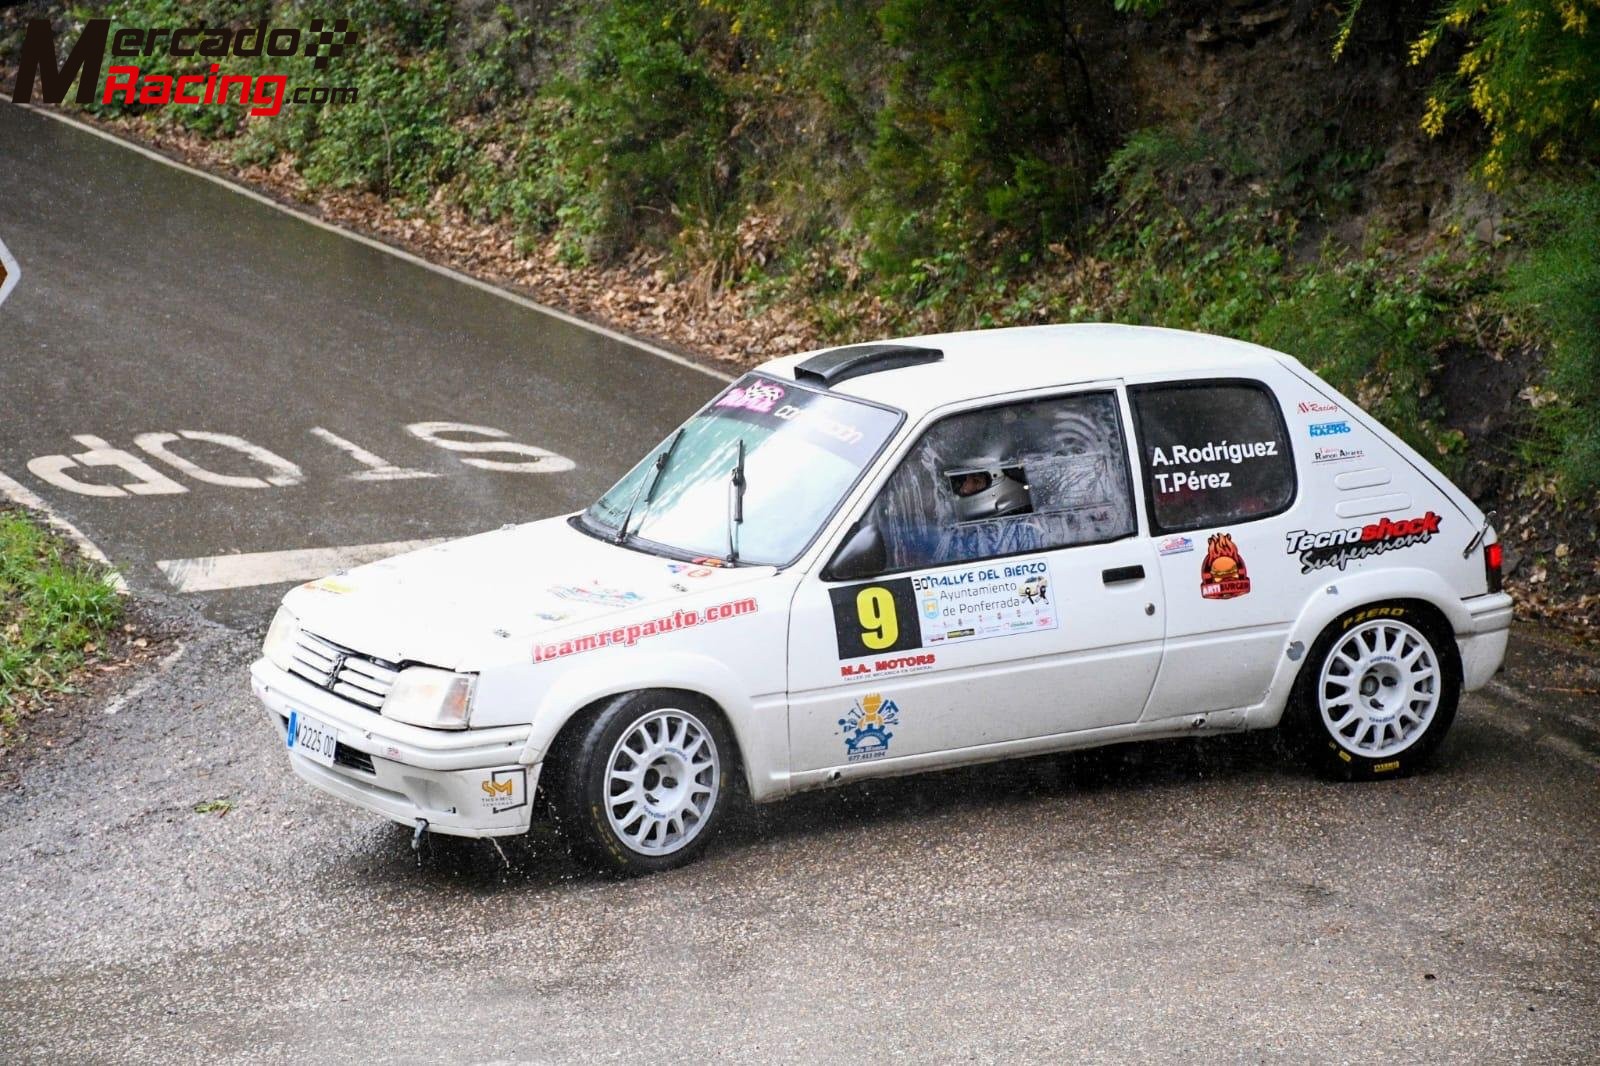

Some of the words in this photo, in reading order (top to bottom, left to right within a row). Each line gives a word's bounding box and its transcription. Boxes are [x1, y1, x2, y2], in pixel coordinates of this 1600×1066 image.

[26, 421, 577, 498] STOP
[1152, 440, 1278, 467] A.Rodríguez
[1155, 471, 1232, 493] T.Pérez
[1286, 511, 1441, 554] Tecnoshock
[931, 572, 974, 588] RALLYE
[978, 568, 1000, 582] DEL
[1004, 562, 1047, 577] BIERZO
[940, 582, 1017, 602] Ayuntamiento
[856, 586, 899, 650] 9
[942, 605, 956, 617] de
[960, 597, 1020, 615] Ponferrada
[533, 597, 758, 664] teamrepauto.com
[841, 663, 871, 676] M.A.
[875, 654, 936, 671] MOTORS
[301, 724, 322, 752] 2225
